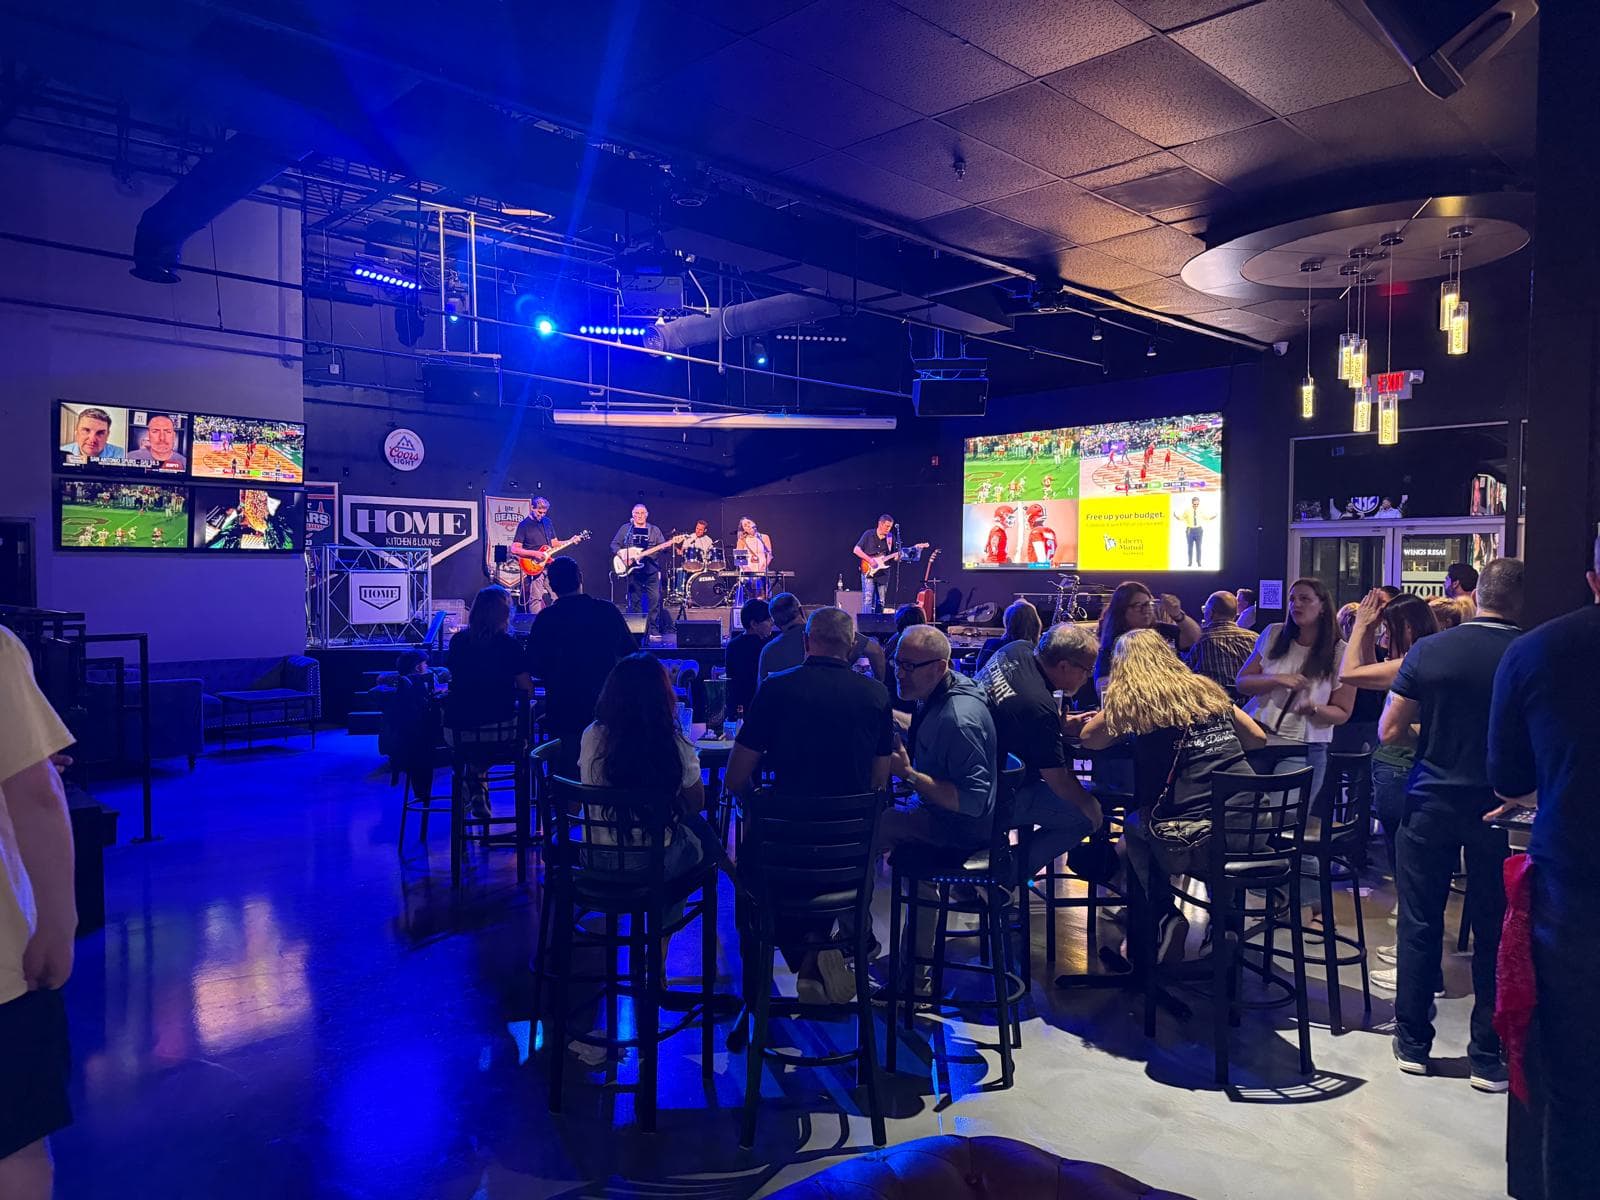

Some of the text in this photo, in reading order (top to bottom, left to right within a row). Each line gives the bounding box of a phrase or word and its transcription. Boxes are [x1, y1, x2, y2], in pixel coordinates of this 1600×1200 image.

[1378, 372, 1405, 392] EXIT
[390, 447, 418, 460] Coors
[394, 458, 414, 466] LIGHT
[357, 509, 467, 535] HOME
[1115, 513, 1133, 521] your
[385, 537, 412, 546] KITCHEN
[418, 538, 442, 547] LOUNGE
[364, 589, 397, 598] HOME
